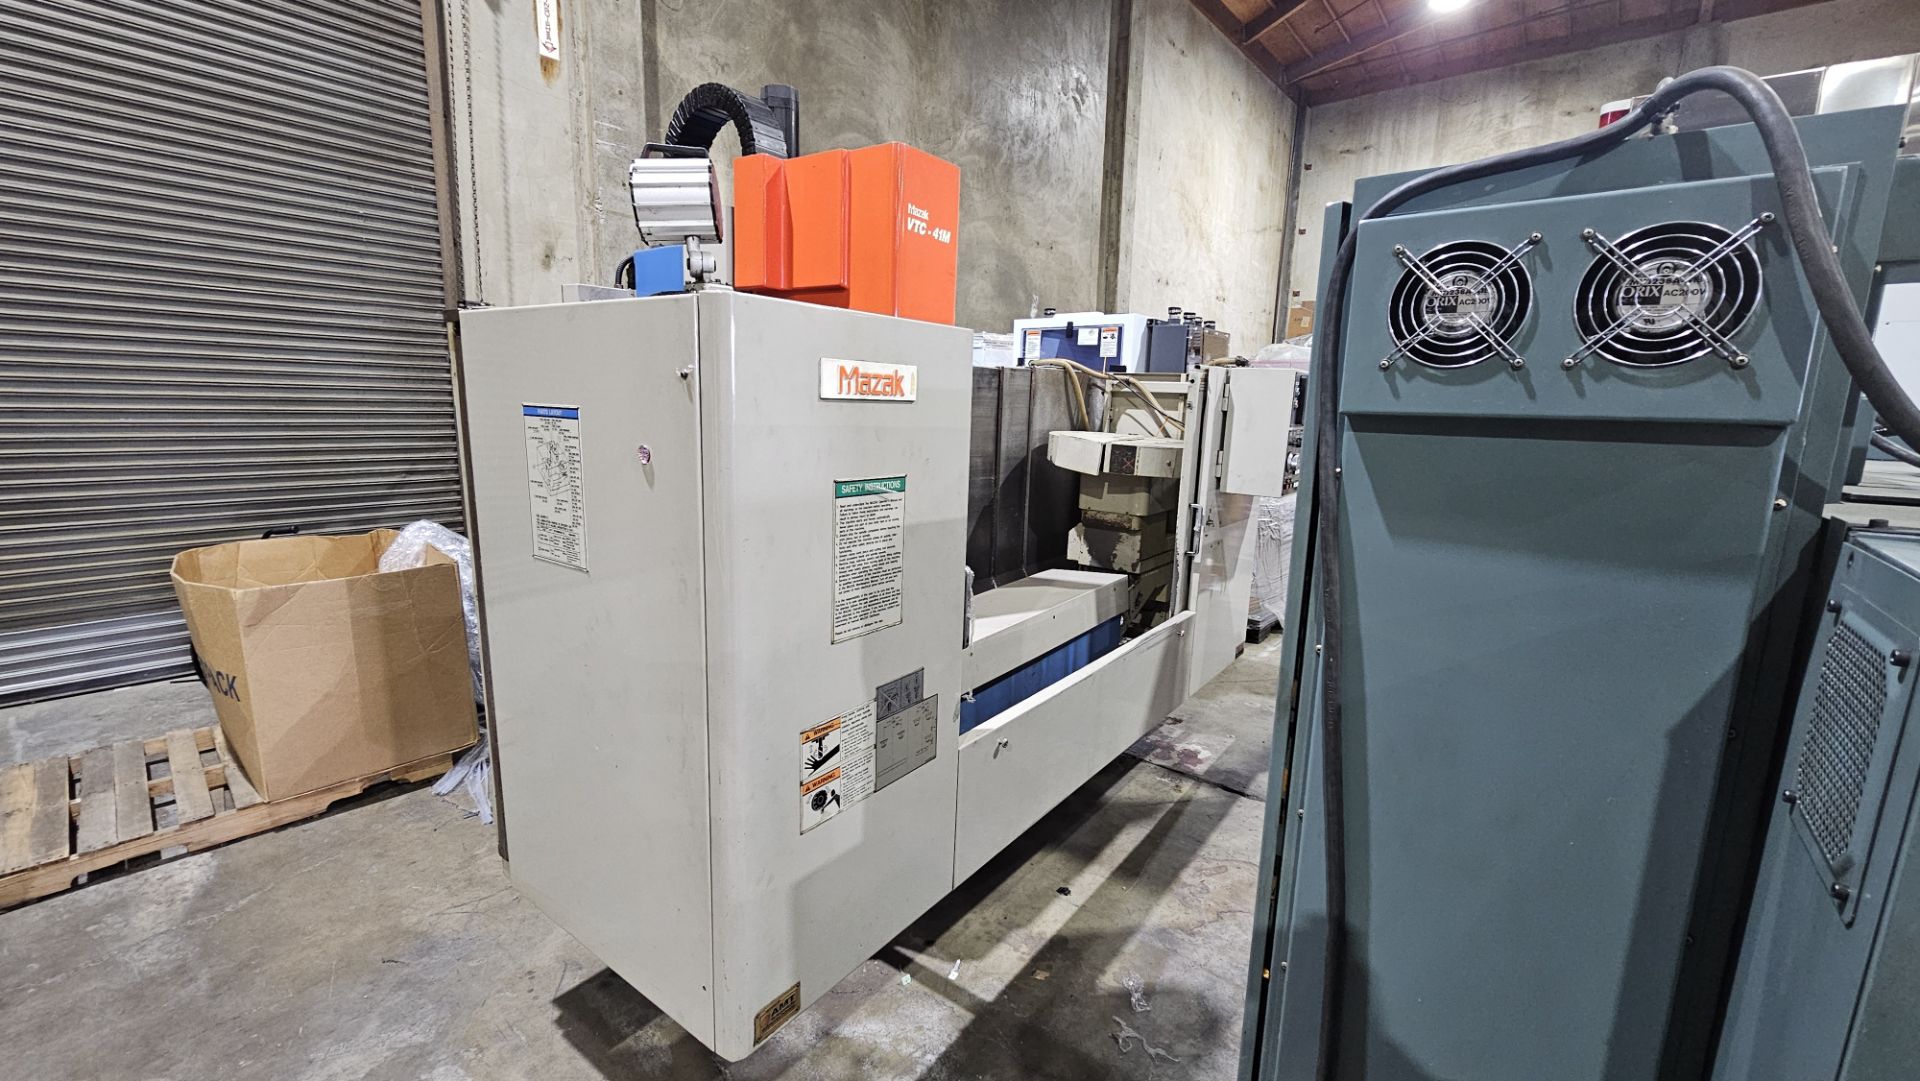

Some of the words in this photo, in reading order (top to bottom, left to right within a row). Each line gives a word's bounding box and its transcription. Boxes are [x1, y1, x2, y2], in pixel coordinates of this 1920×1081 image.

[1622, 286, 1660, 298] ORIX
[838, 364, 905, 398] Mazak
[841, 483, 863, 494] SAFETY
[864, 480, 901, 491] INSTRUCTIONS
